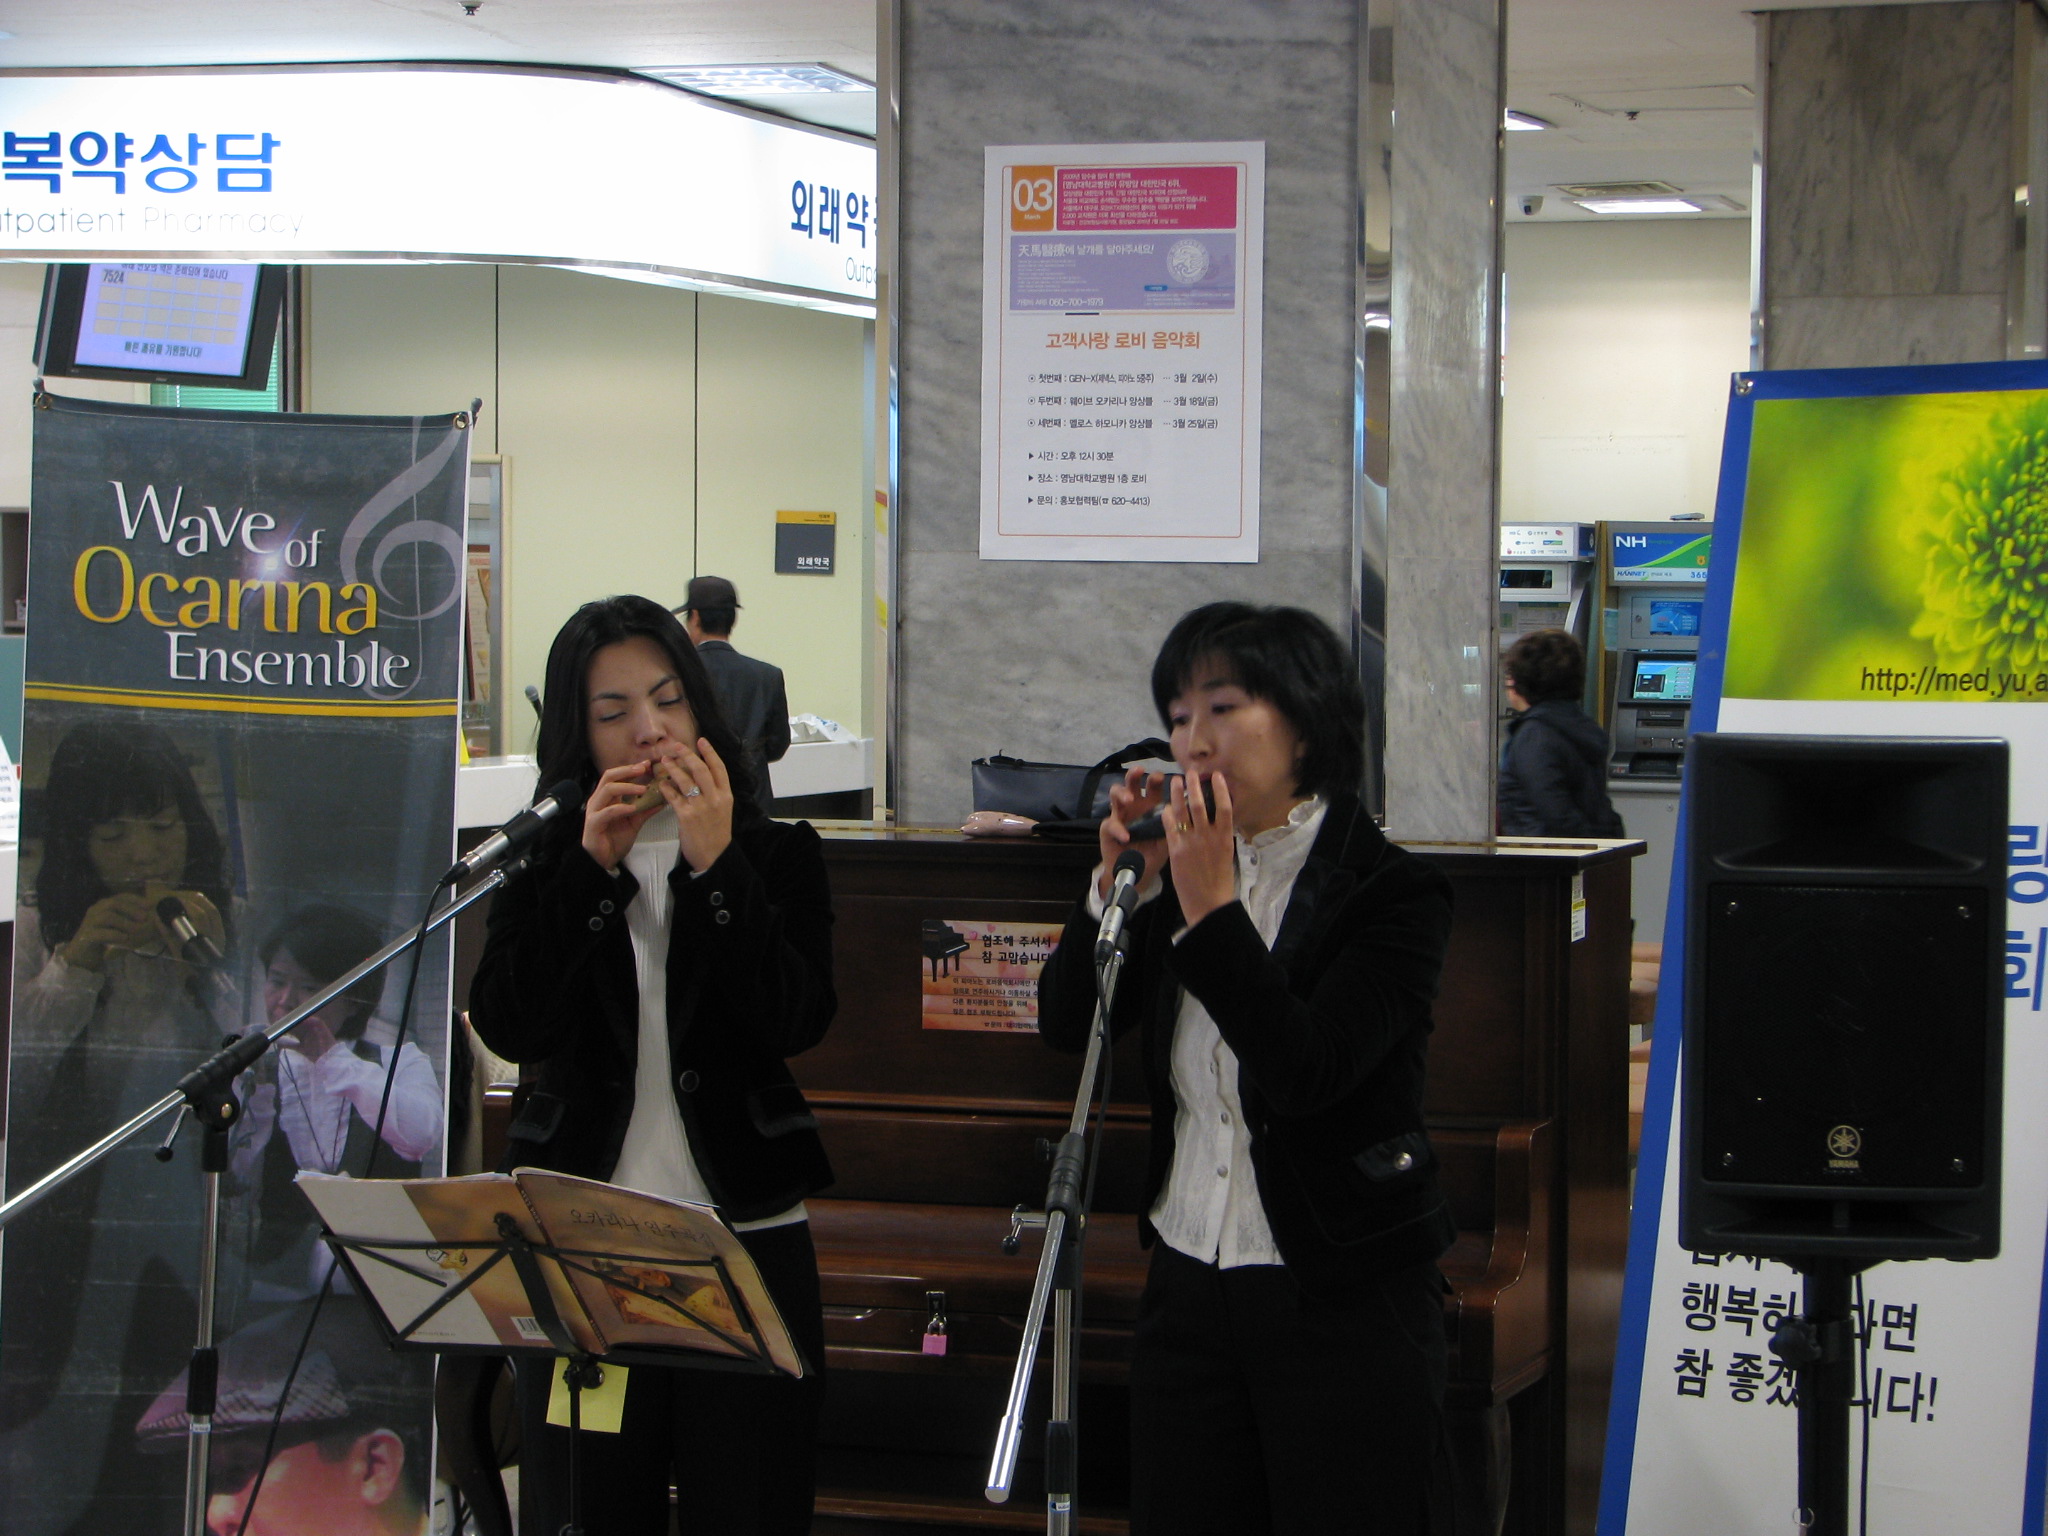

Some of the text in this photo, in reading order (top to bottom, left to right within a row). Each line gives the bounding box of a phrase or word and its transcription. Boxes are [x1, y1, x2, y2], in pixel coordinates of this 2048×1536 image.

[2, 131, 281, 194] 복약상담
[1014, 179, 1053, 211] 03
[791, 180, 877, 249] 외래약
[145, 206, 304, 239] Pharmacy
[1077, 243, 1103, 256] 날개를
[1106, 243, 1155, 255] 달아주세요!
[103, 269, 125, 284] 7524
[1045, 331, 1200, 350] 고객사랑 로비 음악회
[1038, 373, 1062, 384] 첫번째
[1173, 373, 1187, 383] 3월
[1191, 373, 1218, 384] 2일(수)
[1038, 396, 1062, 406] 두번째
[1095, 396, 1127, 406] 오카리나
[1129, 396, 1153, 407] 앙상블
[1173, 396, 1186, 407] 3월
[1189, 396, 1219, 407] 18일(금)
[1038, 418, 1062, 428] 세번째
[1095, 418, 1127, 429] 하모니카
[1129, 418, 1152, 429] 앙상블
[1172, 418, 1185, 429] 3월
[1187, 418, 1218, 429] 25일(금)
[1038, 451, 1054, 461] 시간
[1061, 451, 1077, 461] 오후
[1079, 451, 1095, 461] 12시
[1096, 451, 1115, 461] 30분
[1037, 473, 1053, 484] 장소
[1060, 473, 1115, 484] 영남대학교병원
[1117, 474, 1129, 484] 1층
[1131, 473, 1147, 484] 로비
[1037, 496, 1053, 506] 문의
[1111, 496, 1151, 506] 620-4413)
[109, 480, 326, 569] Wave of
[1615, 535, 1647, 548] NH
[797, 556, 830, 567] 외래약국
[1690, 571, 1708, 579] 365
[73, 545, 379, 637] Ocarina
[164, 631, 411, 690] Ensemble
[982, 934, 1051, 948] 협조해 주셔서
[982, 951, 992, 964] 참
[570, 1208, 640, 1234] 오카리나
[1673, 1347, 1938, 1423] 참 좋겠니다!
